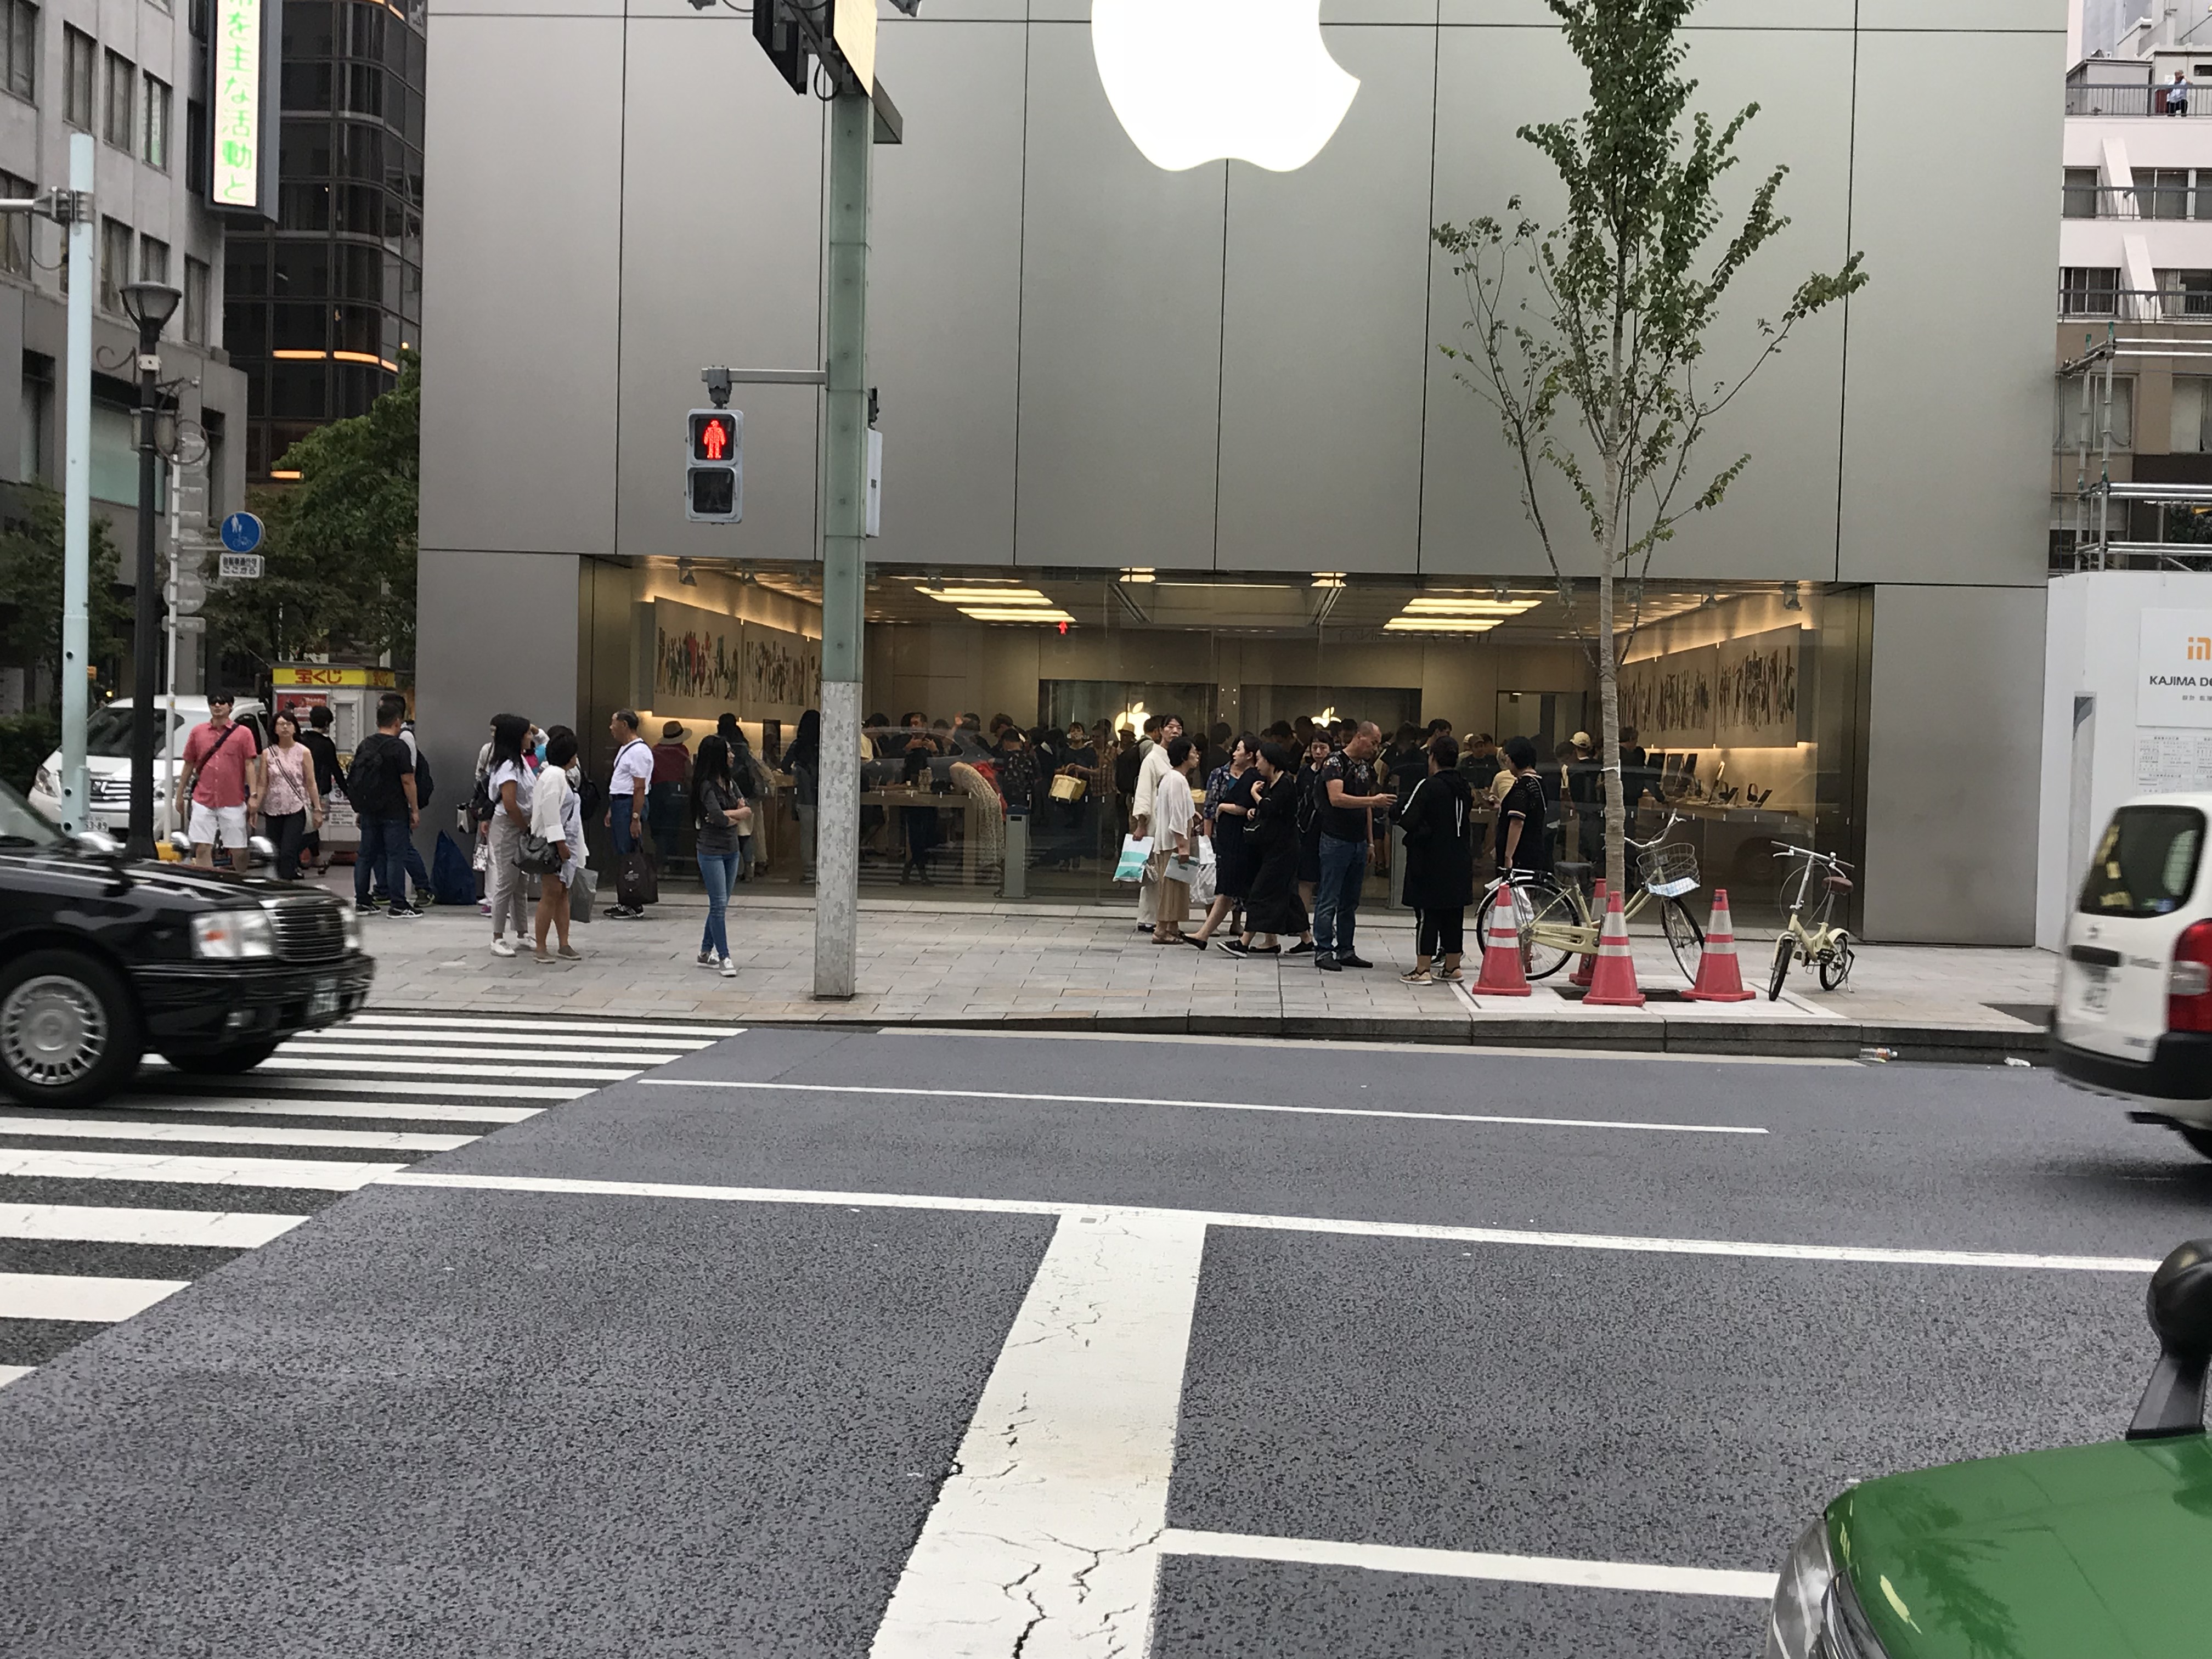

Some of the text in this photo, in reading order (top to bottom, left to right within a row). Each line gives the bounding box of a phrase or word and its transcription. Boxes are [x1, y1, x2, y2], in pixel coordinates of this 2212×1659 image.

[223, 566, 256, 575] ここから
[295, 669, 342, 684] 宝くじ
[2149, 675, 2196, 686] KAJIMA
